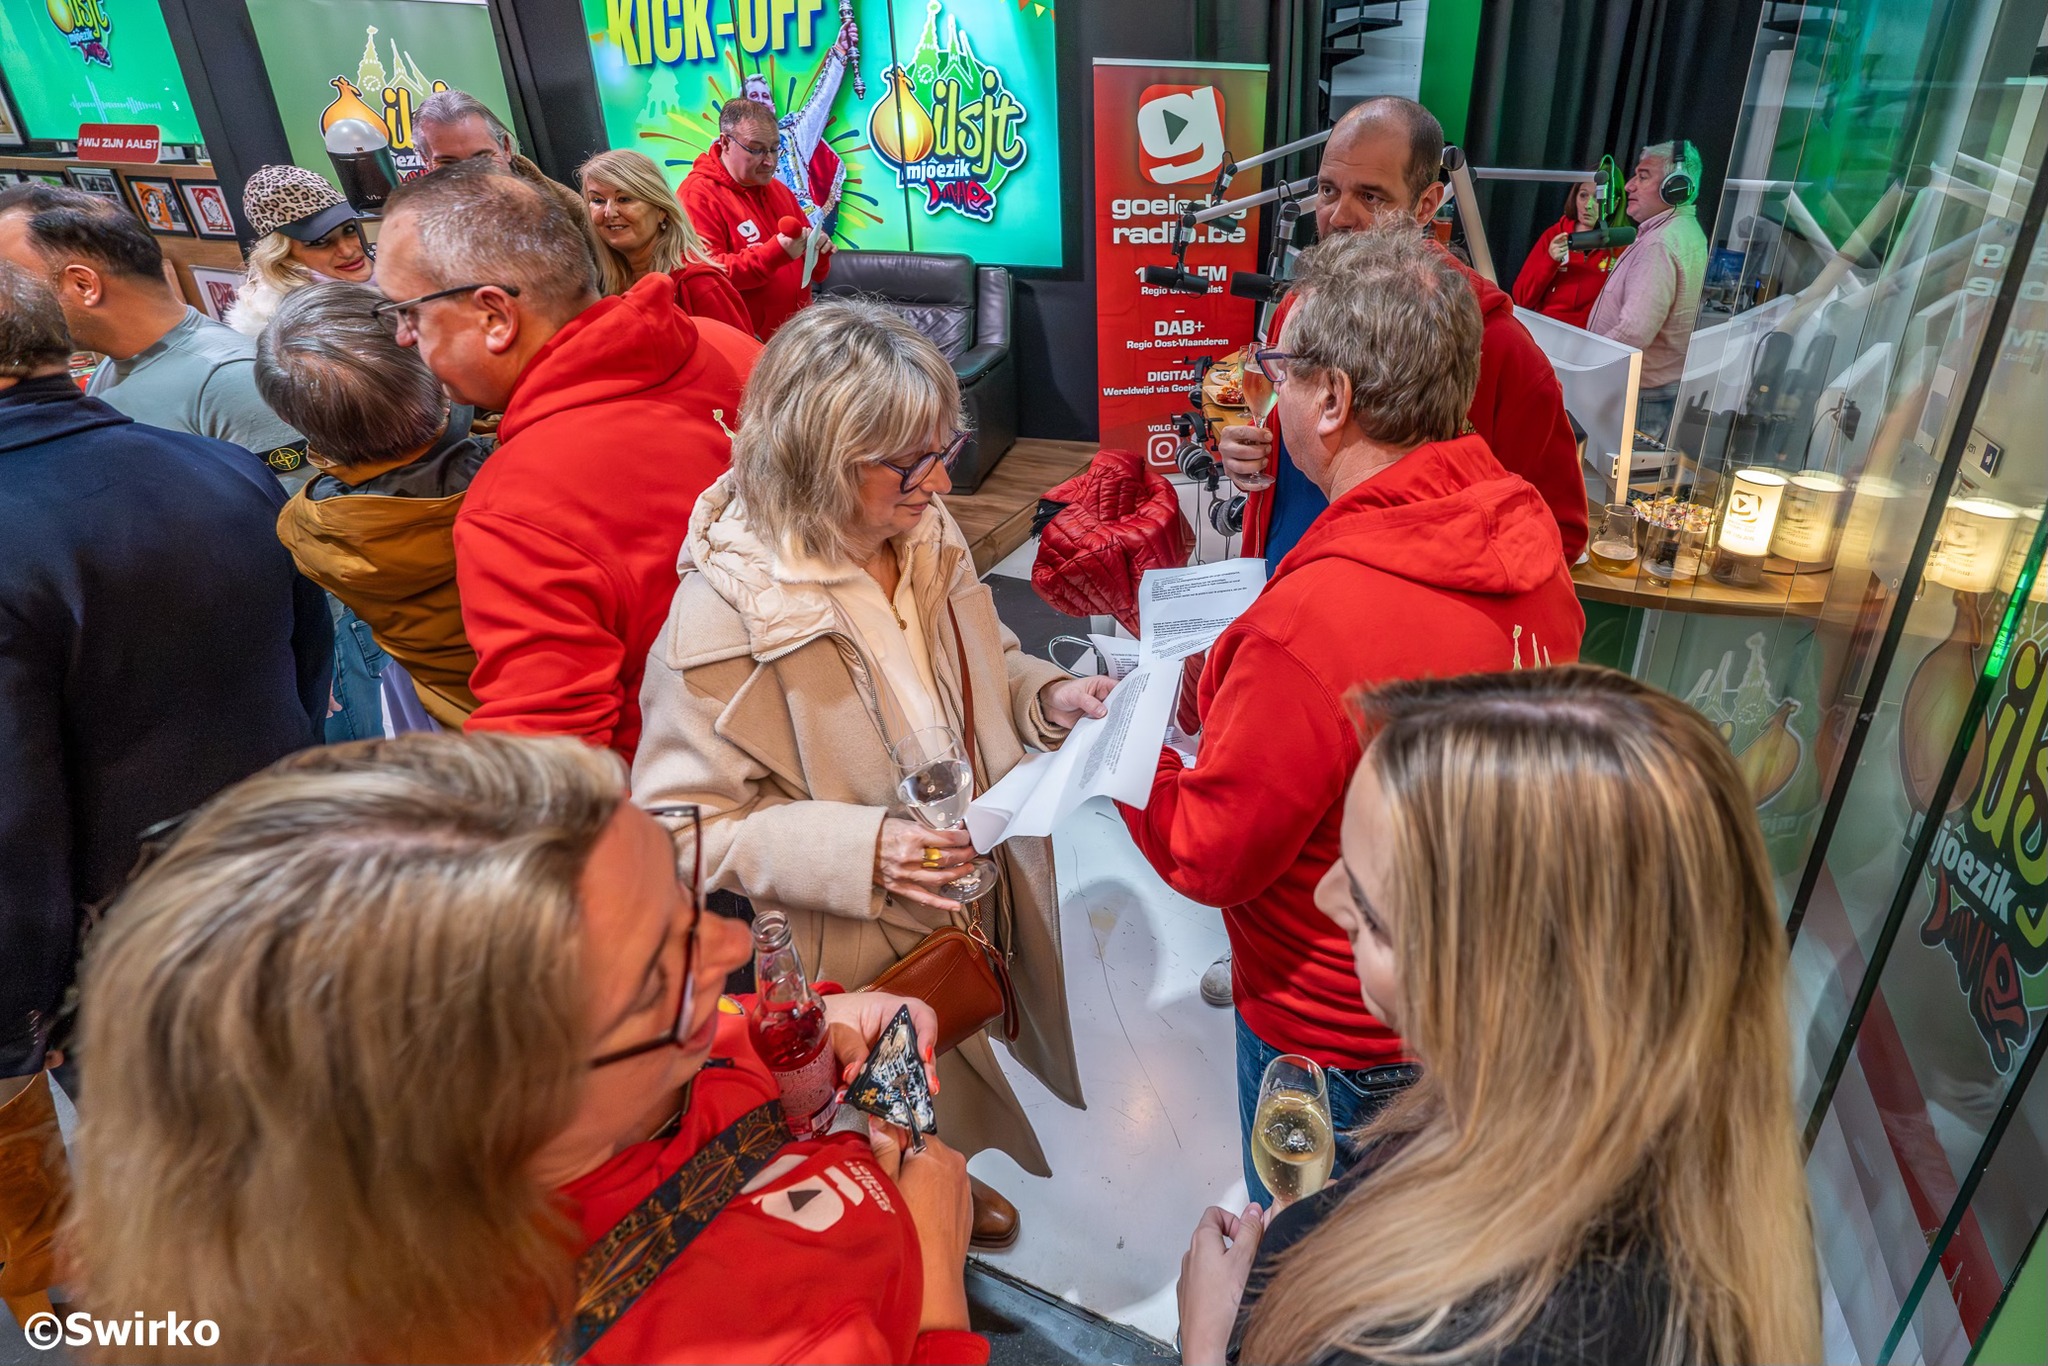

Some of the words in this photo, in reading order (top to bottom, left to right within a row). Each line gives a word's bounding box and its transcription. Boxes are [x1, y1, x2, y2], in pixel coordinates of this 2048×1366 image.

[101, 138, 124, 149] ZIJN
[125, 139, 159, 149] AALST
[906, 158, 971, 182] mjoezik
[1198, 266, 1227, 281] FM
[1141, 286, 1168, 296] Regio
[1155, 320, 1205, 336] DAB+
[1126, 340, 1153, 350] Regio
[1154, 338, 1229, 348] Oost-Vlaanderen
[1147, 370, 1196, 382] DIGITAA
[1103, 385, 1154, 396] Wereldwijd
[1156, 385, 1170, 393] via
[1148, 424, 1171, 432] VOLG
